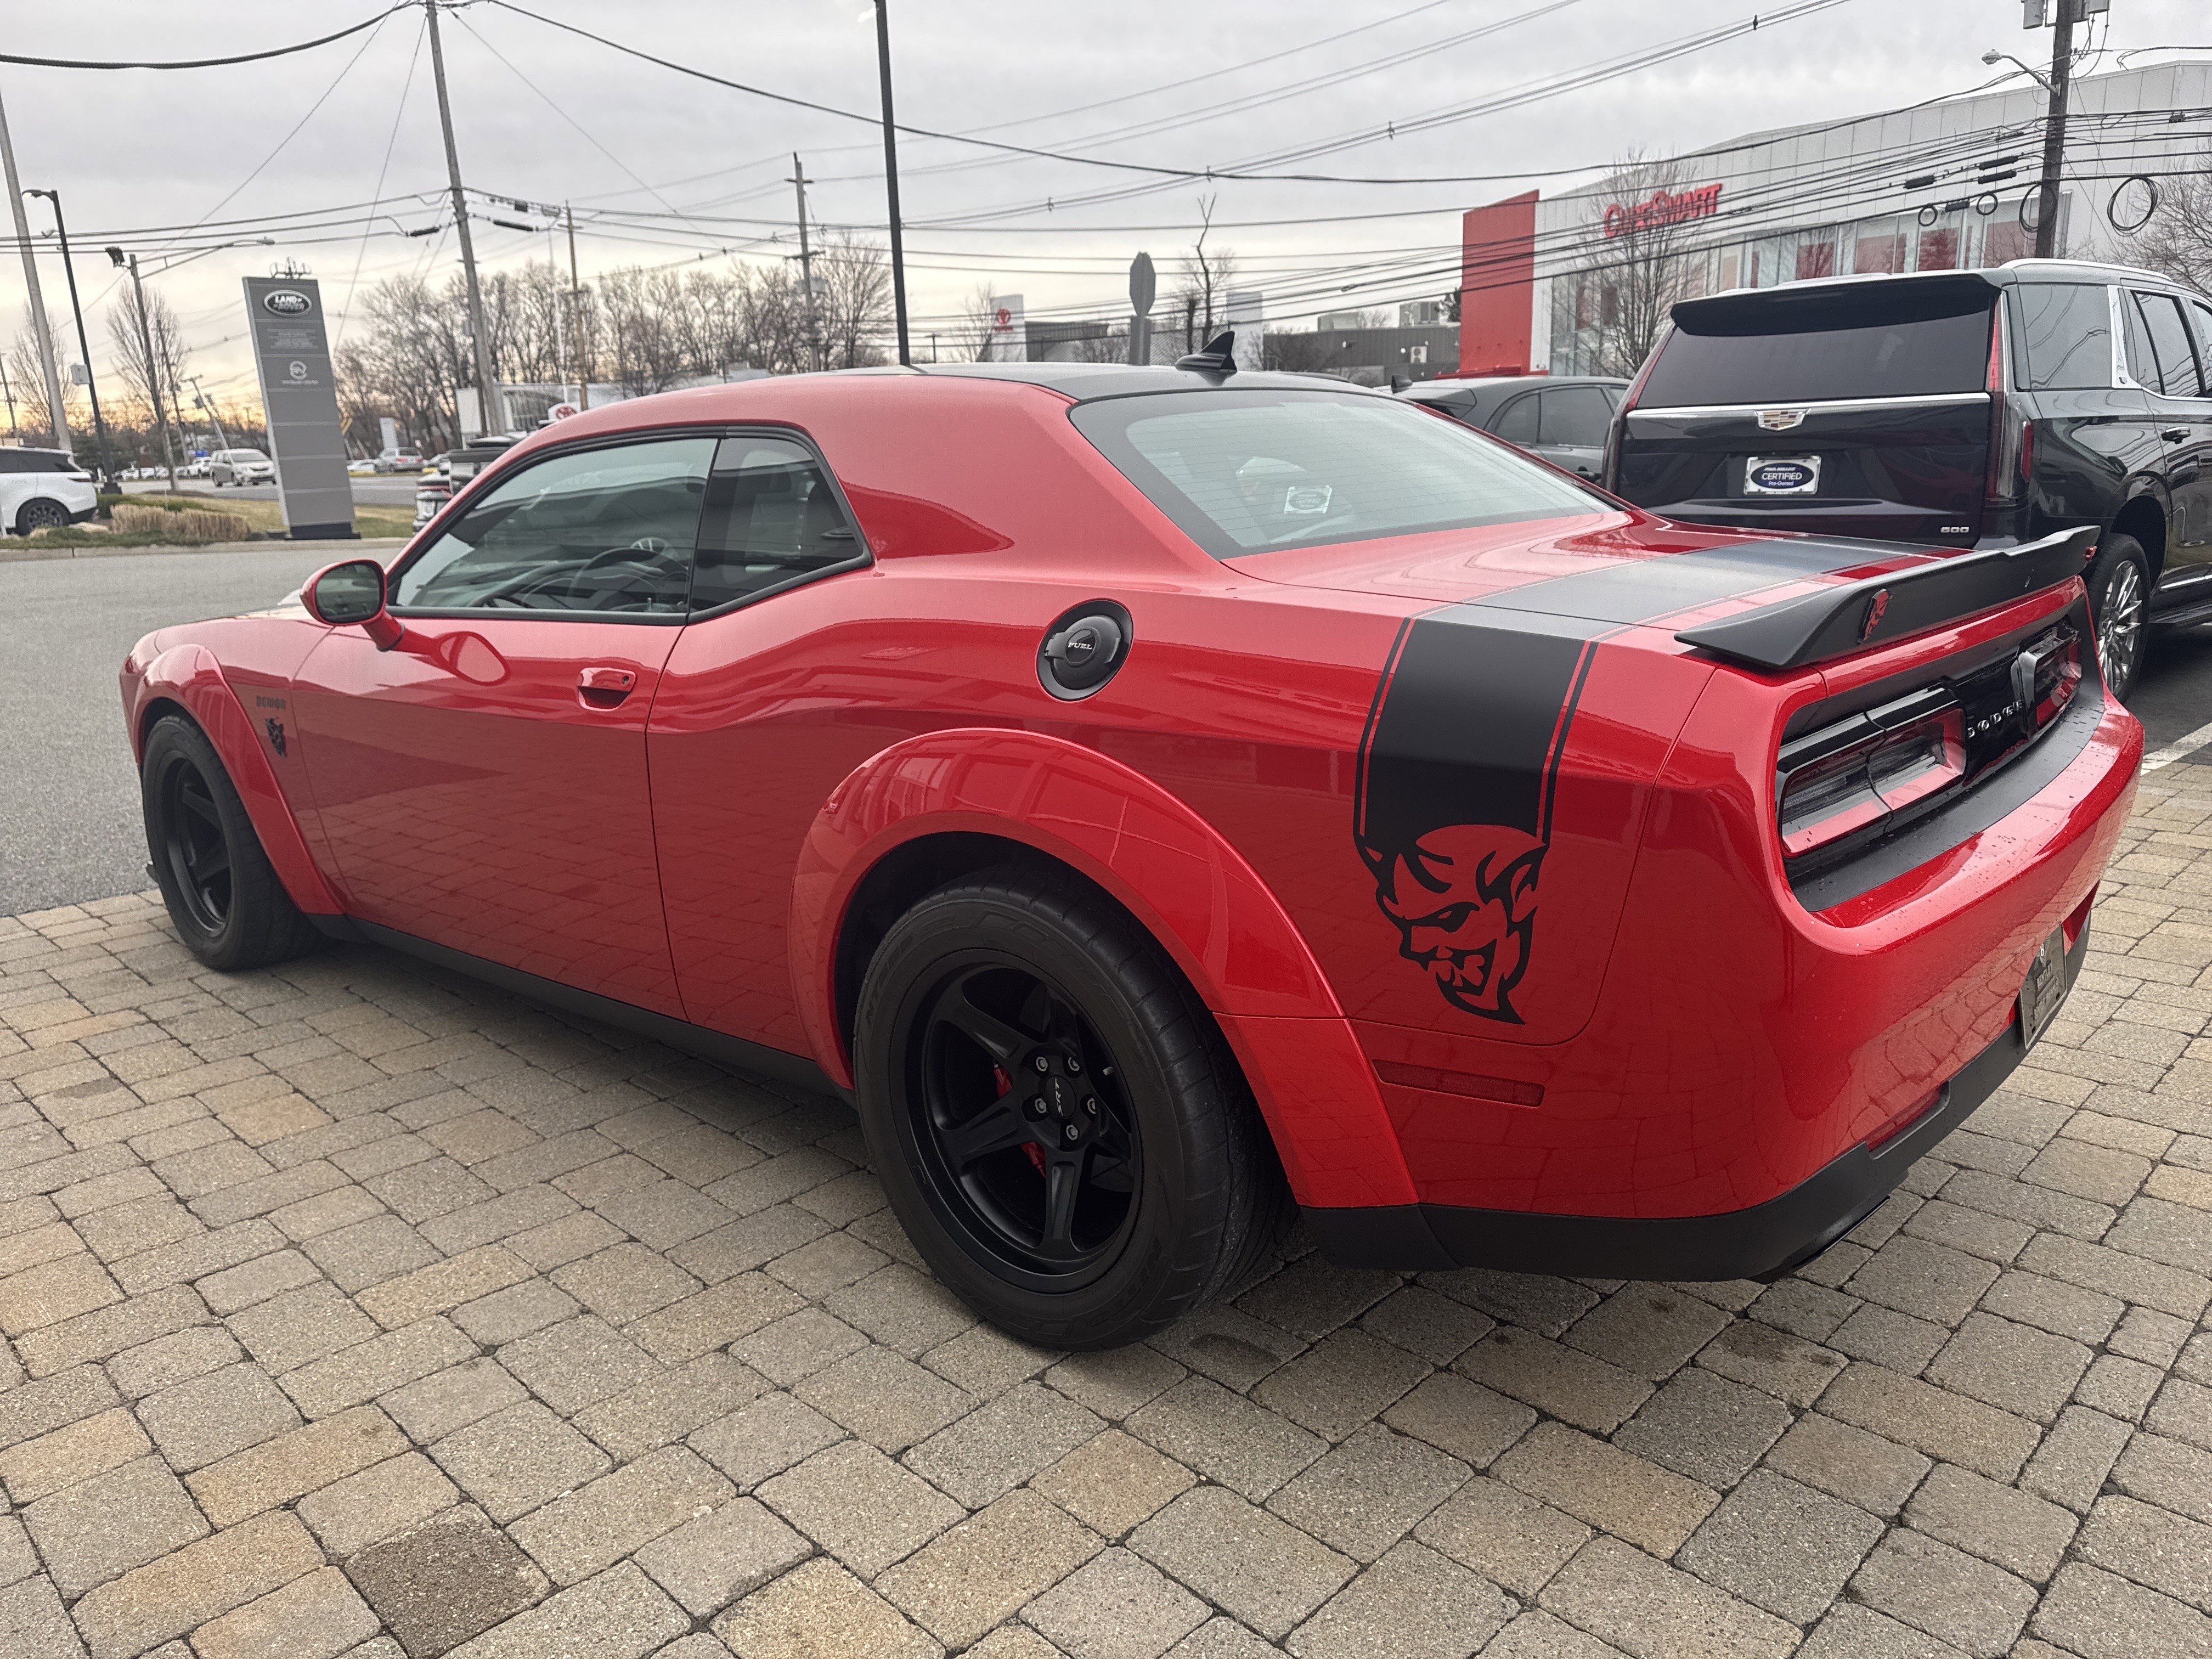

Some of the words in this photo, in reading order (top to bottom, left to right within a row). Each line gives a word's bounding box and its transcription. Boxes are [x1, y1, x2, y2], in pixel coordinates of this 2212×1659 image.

[275, 295, 297, 304] LAND
[1967, 700, 2023, 738] DODGE
[1054, 1077, 1063, 1117] SRT
